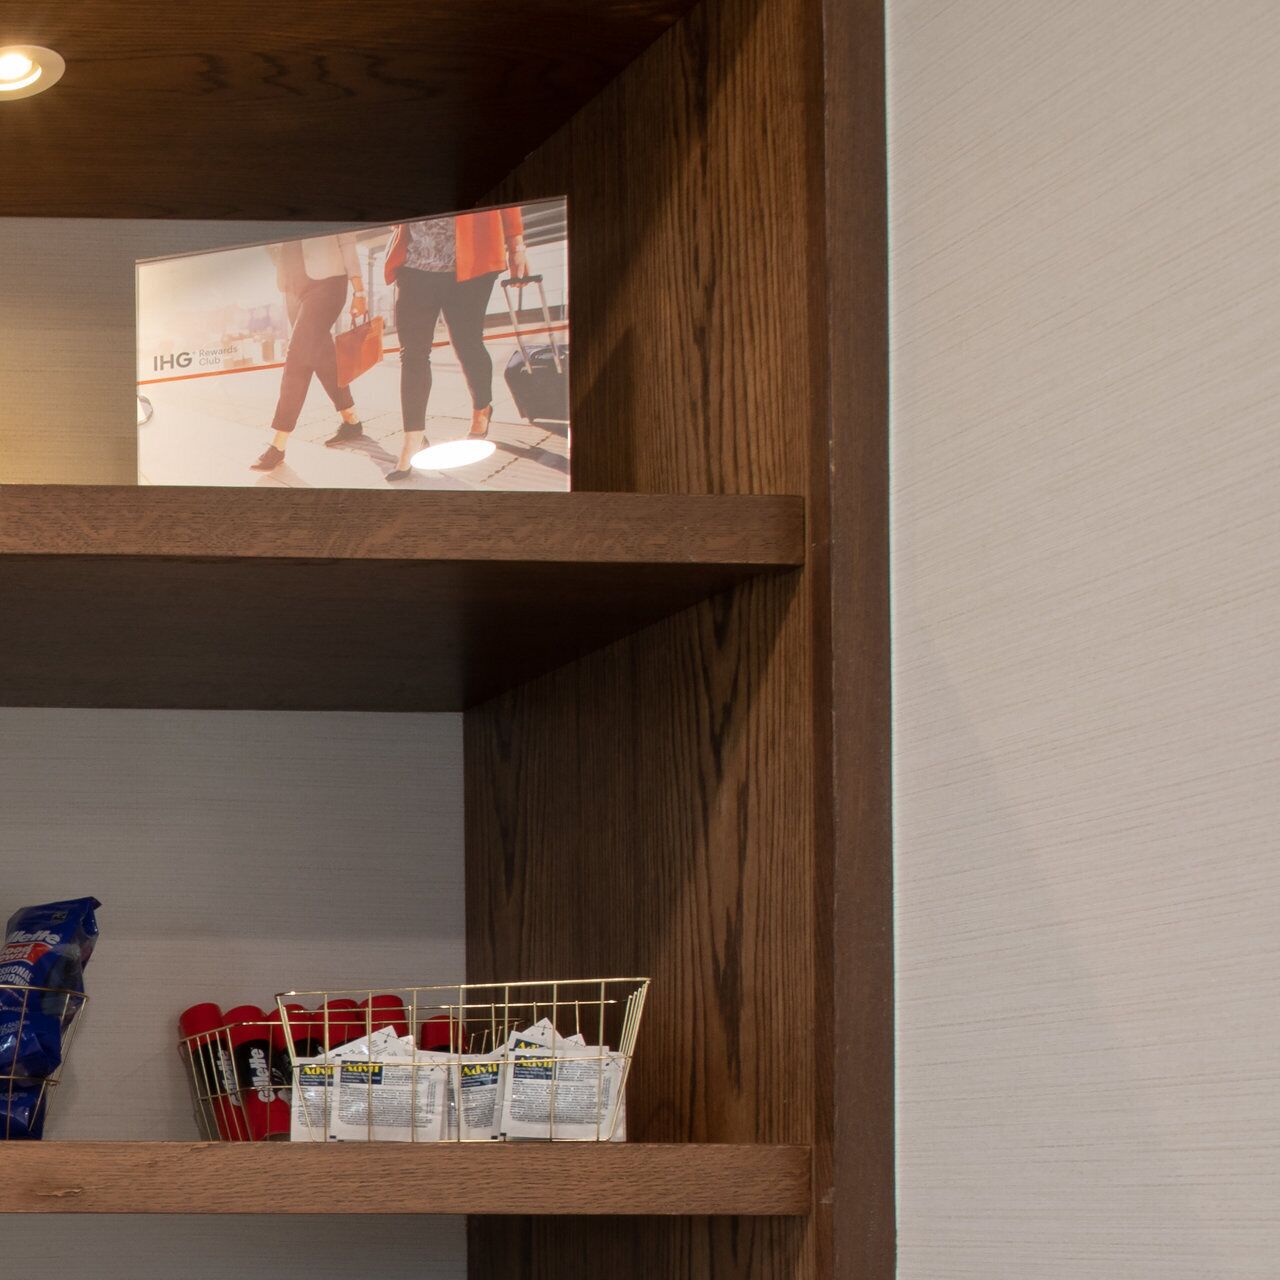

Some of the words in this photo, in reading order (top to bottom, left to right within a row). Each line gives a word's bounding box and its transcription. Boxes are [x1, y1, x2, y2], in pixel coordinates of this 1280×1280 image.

[153, 352, 192, 371] IHG
[199, 345, 238, 357] Rewards
[199, 357, 221, 366] Club
[248, 1046, 276, 1104] Gillette
[461, 1063, 498, 1076] Advil
